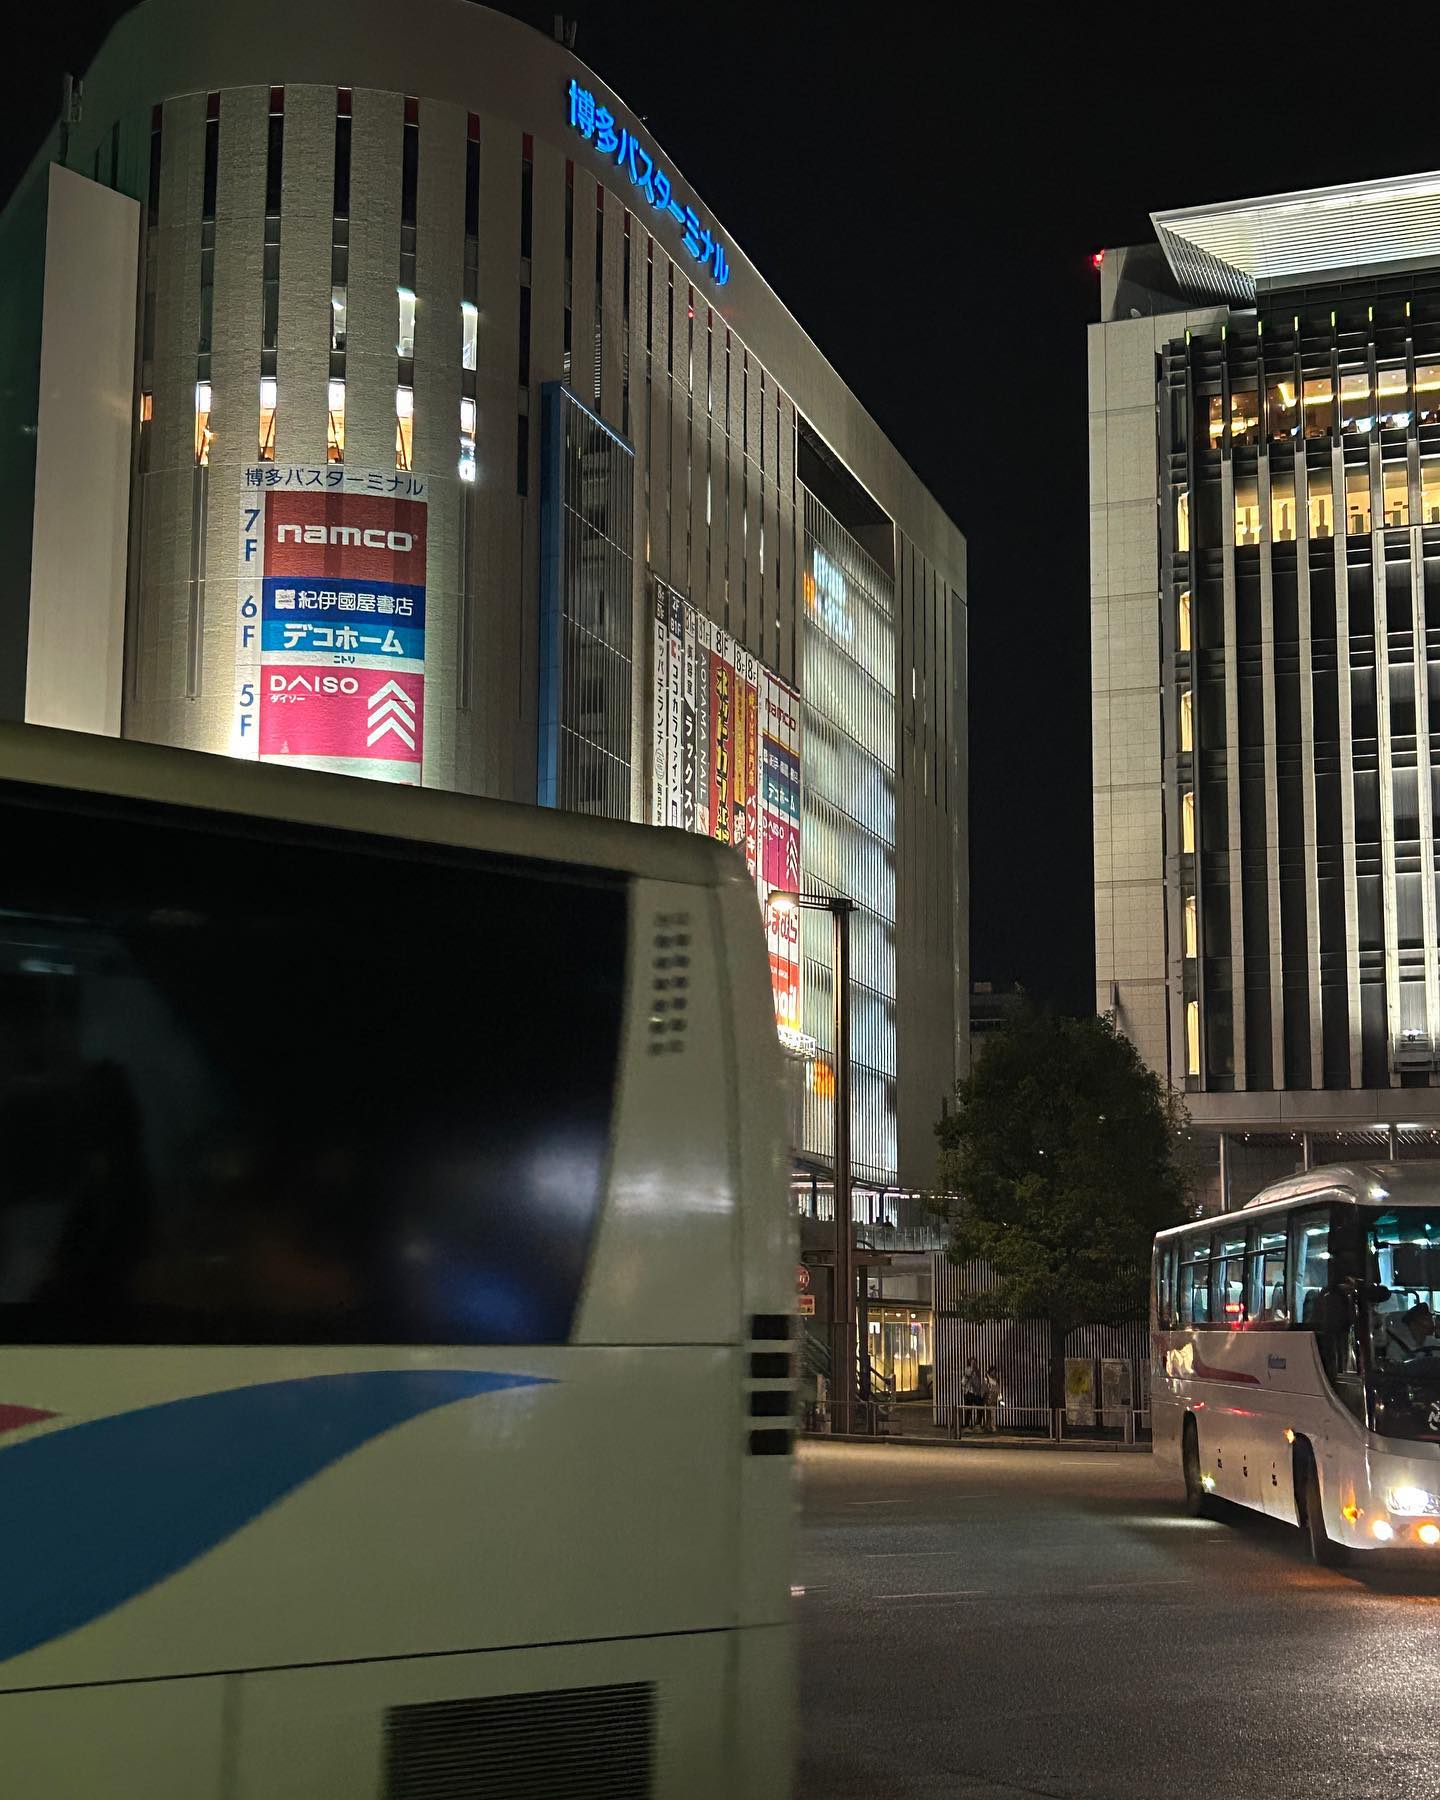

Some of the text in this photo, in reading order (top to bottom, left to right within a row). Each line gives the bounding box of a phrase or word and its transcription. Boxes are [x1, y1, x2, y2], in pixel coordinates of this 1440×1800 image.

[569, 79, 729, 285] 博多バスターミナル
[245, 467, 424, 496] 博多バスターミナル
[277, 523, 413, 552] namco
[297, 590, 413, 616] 紀伊國屋書店
[283, 623, 403, 655] デコホーム
[716, 630, 728, 658] 8F
[333, 655, 355, 664] ニトリ
[736, 654, 745, 675] 8F
[747, 655, 756, 682] 8F
[269, 693, 305, 703] ダイソー
[270, 675, 358, 694] DAISO
[700, 653, 708, 741] AOYAMA
[672, 664, 680, 793] ココカラファイン
